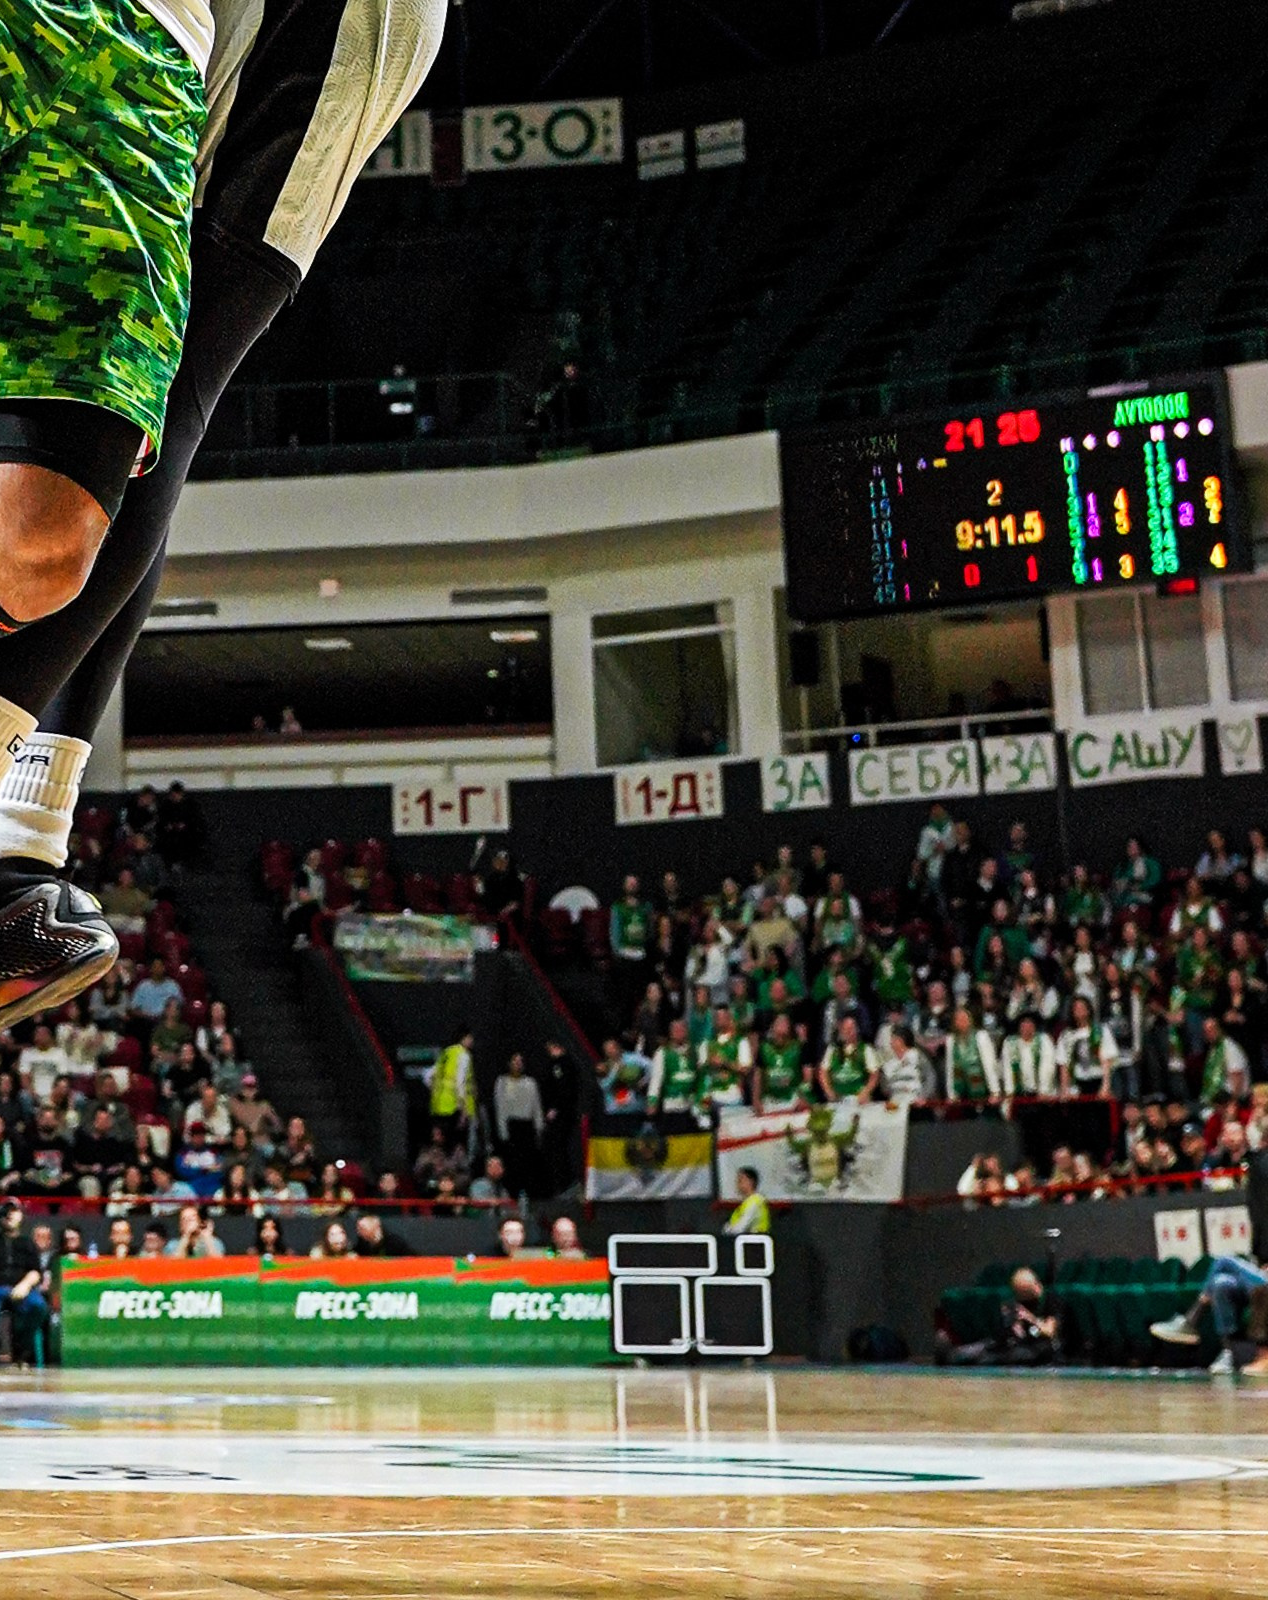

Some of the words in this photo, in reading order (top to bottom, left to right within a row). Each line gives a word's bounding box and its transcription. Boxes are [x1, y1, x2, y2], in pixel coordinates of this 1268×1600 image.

[1113, 391, 1190, 428] AVTODOR
[943, 419, 985, 453] 21
[985, 478, 1004, 507] 2
[954, 509, 1046, 552] 9:11.5
[769, 757, 827, 811] ЗА
[854, 744, 972, 800] СЕБЯ
[1003, 734, 1052, 790] ЗА
[1071, 720, 1199, 780] САШУ
[414, 786, 486, 827] 1-Г
[634, 771, 702, 818] 1-Д
[97, 1290, 223, 1319] ПРЕСС-ЗОНА
[294, 1291, 419, 1320] ПРЕСС-ЗОНА
[489, 1292, 611, 1321] ПРЕСС-ЗОНА
